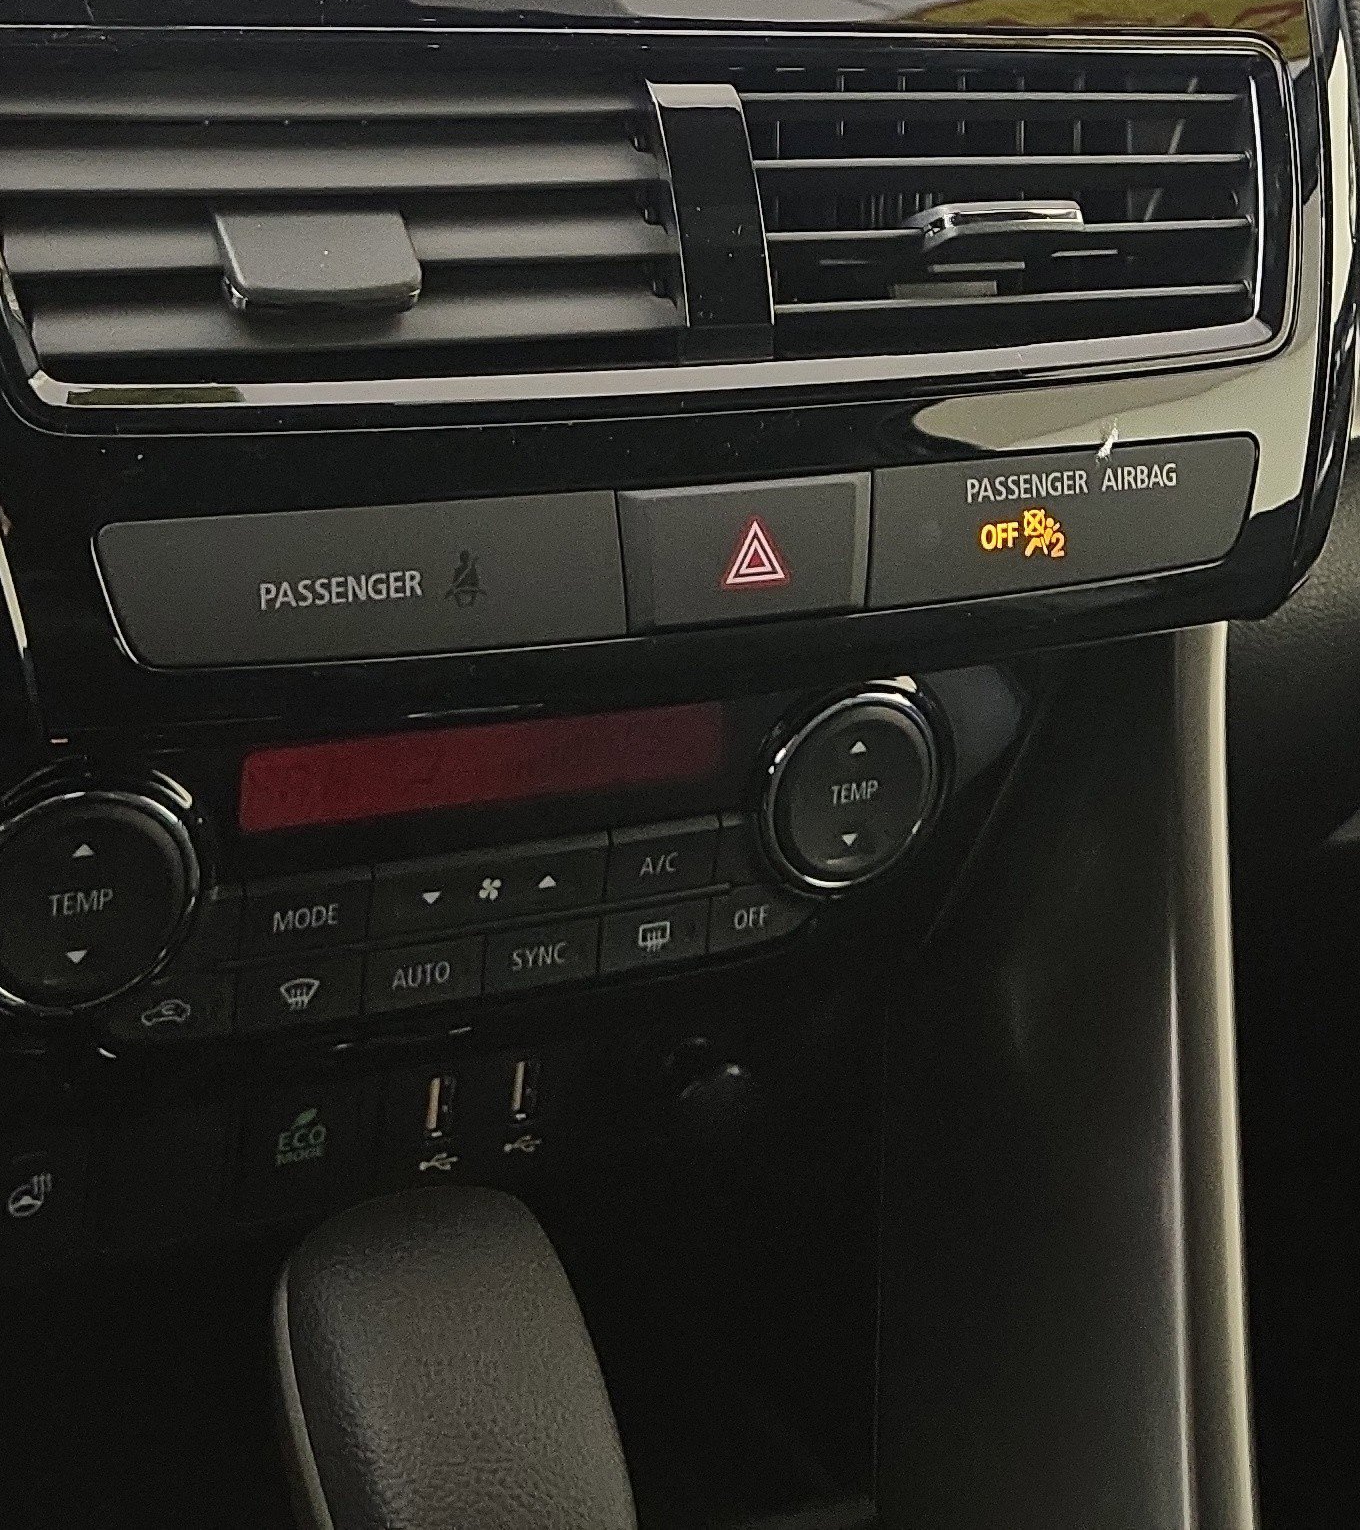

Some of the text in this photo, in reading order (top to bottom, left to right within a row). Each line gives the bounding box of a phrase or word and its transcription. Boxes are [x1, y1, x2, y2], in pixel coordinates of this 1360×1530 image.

[966, 462, 1178, 504] PASSENGER AIRBAG
[980, 521, 1020, 551] OFF
[259, 570, 423, 611] PASSENGER
[831, 779, 879, 806] TEMP
[639, 851, 680, 877] A/C
[48, 886, 115, 917] TEMP
[272, 902, 339, 934] MODE
[732, 904, 770, 931] OFF
[511, 941, 568, 971] SYNC
[391, 960, 452, 991] AUTO
